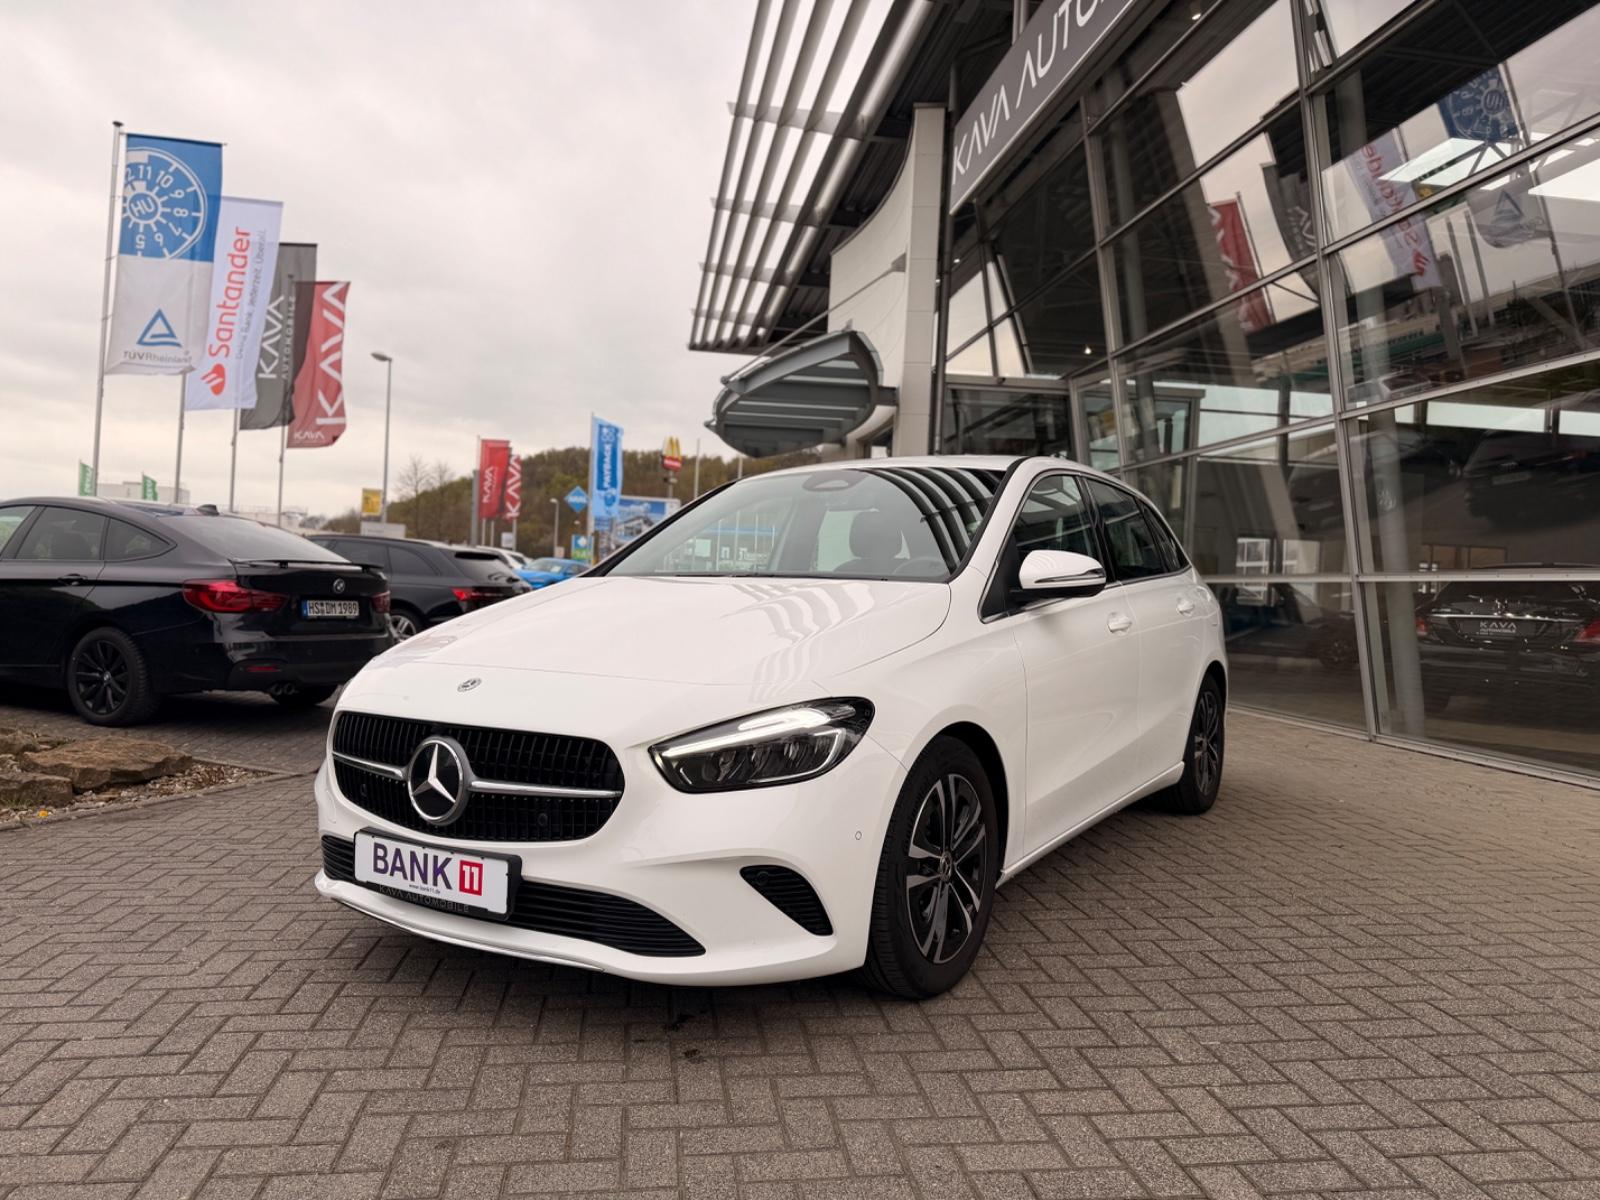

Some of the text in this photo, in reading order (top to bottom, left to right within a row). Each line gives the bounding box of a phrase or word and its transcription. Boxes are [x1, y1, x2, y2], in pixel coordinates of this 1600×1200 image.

[952, 85, 1010, 185] KAVA
[138, 165, 152, 180] 11
[156, 170, 174, 188] 10
[170, 189, 185, 198] 9
[130, 197, 154, 216] HU
[173, 207, 188, 217] 8
[168, 222, 182, 236] 7
[135, 234, 146, 249] 5
[208, 226, 250, 358] Santander
[258, 294, 285, 379] KAVA
[316, 281, 346, 425] KAVA
[505, 455, 521, 518] KAVA
[1479, 621, 1517, 629] KAVA
[373, 842, 480, 892] BANK 11
[380, 884, 469, 913] KAVA AUTOMOBILE
